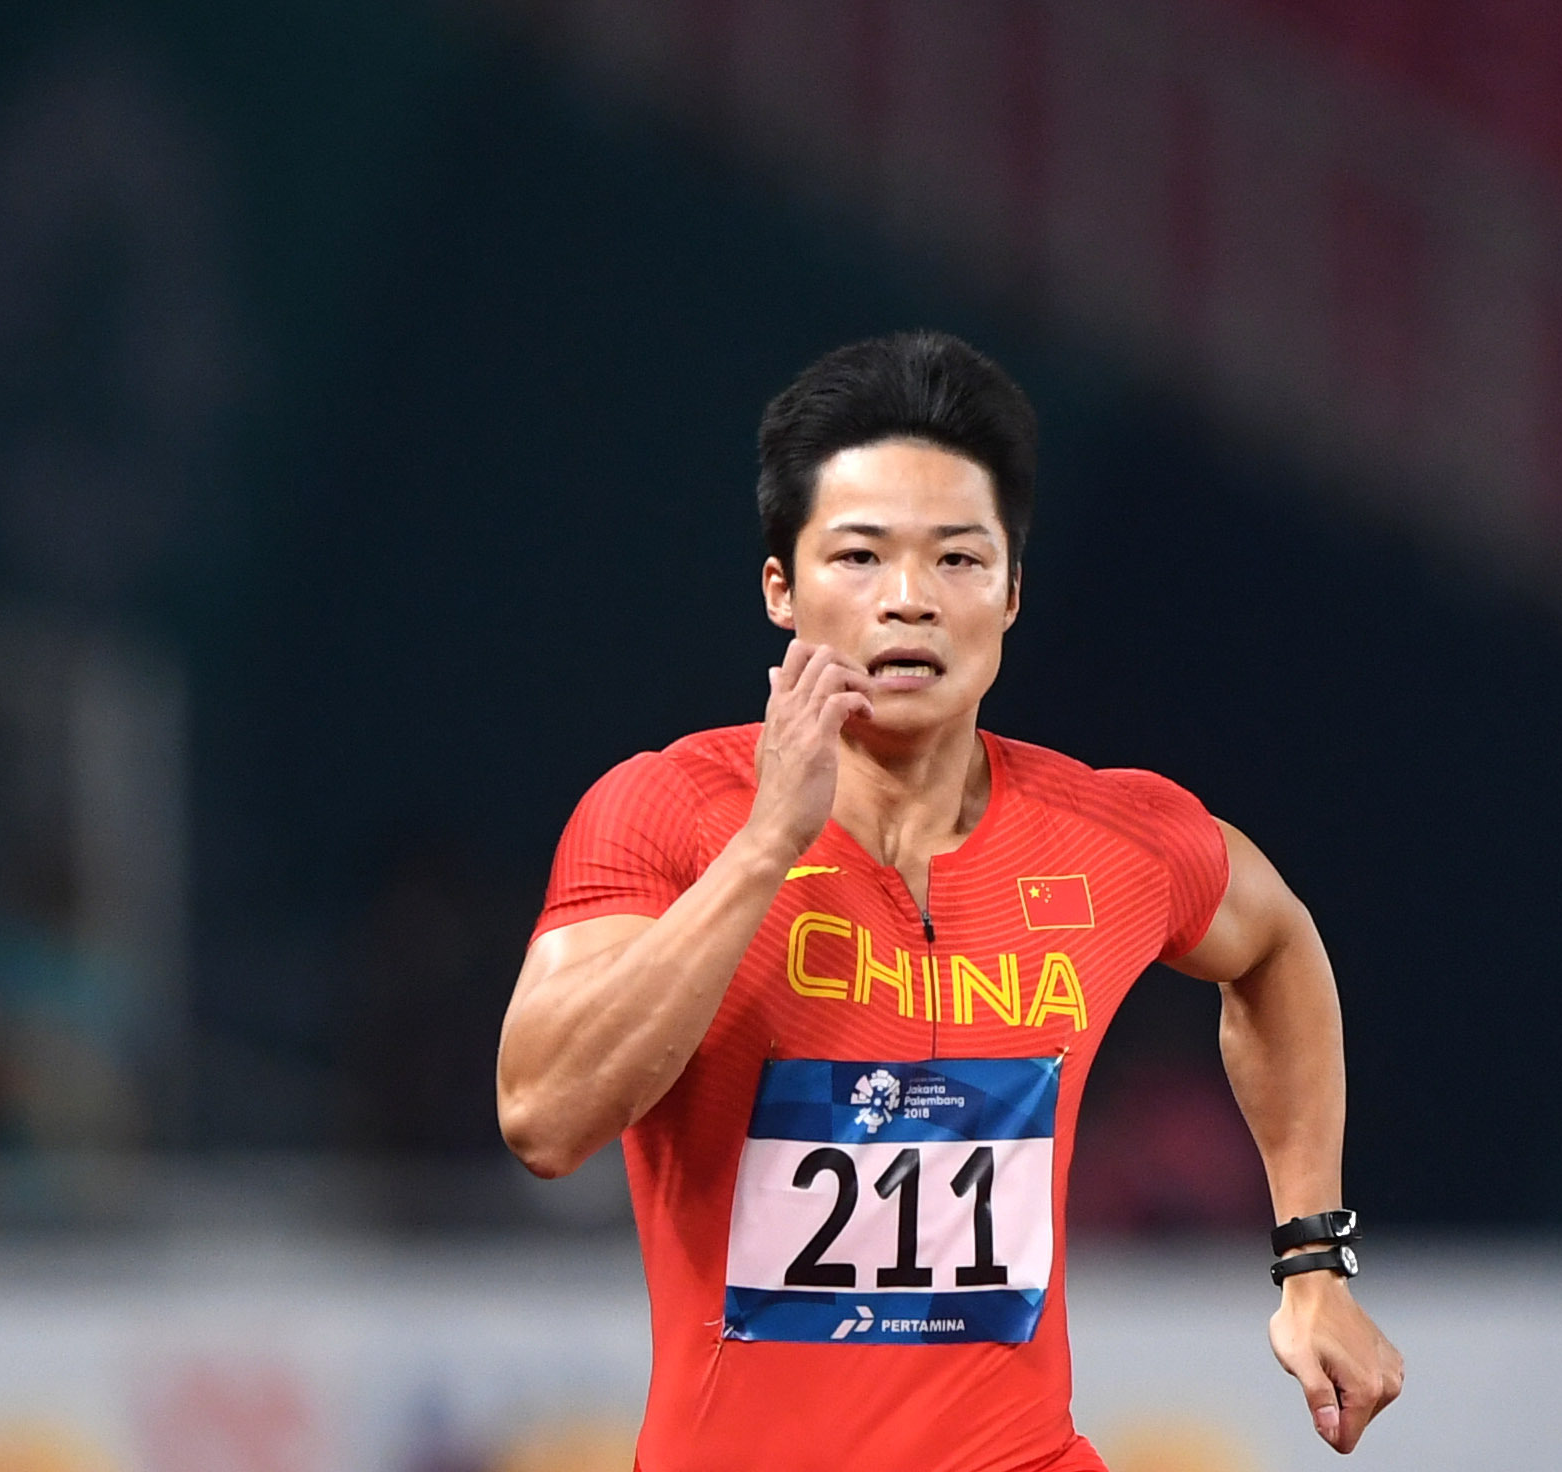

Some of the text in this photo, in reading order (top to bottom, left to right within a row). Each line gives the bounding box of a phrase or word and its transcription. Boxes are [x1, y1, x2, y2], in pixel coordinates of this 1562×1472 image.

[787, 911, 1088, 1032] CHINA
[906, 1085, 946, 1094] Jakarta
[904, 1095, 965, 1108] Palembang
[904, 1107, 930, 1118] 2018
[784, 1147, 1008, 1287] 211
[881, 1319, 965, 1332] PERTAMINA
